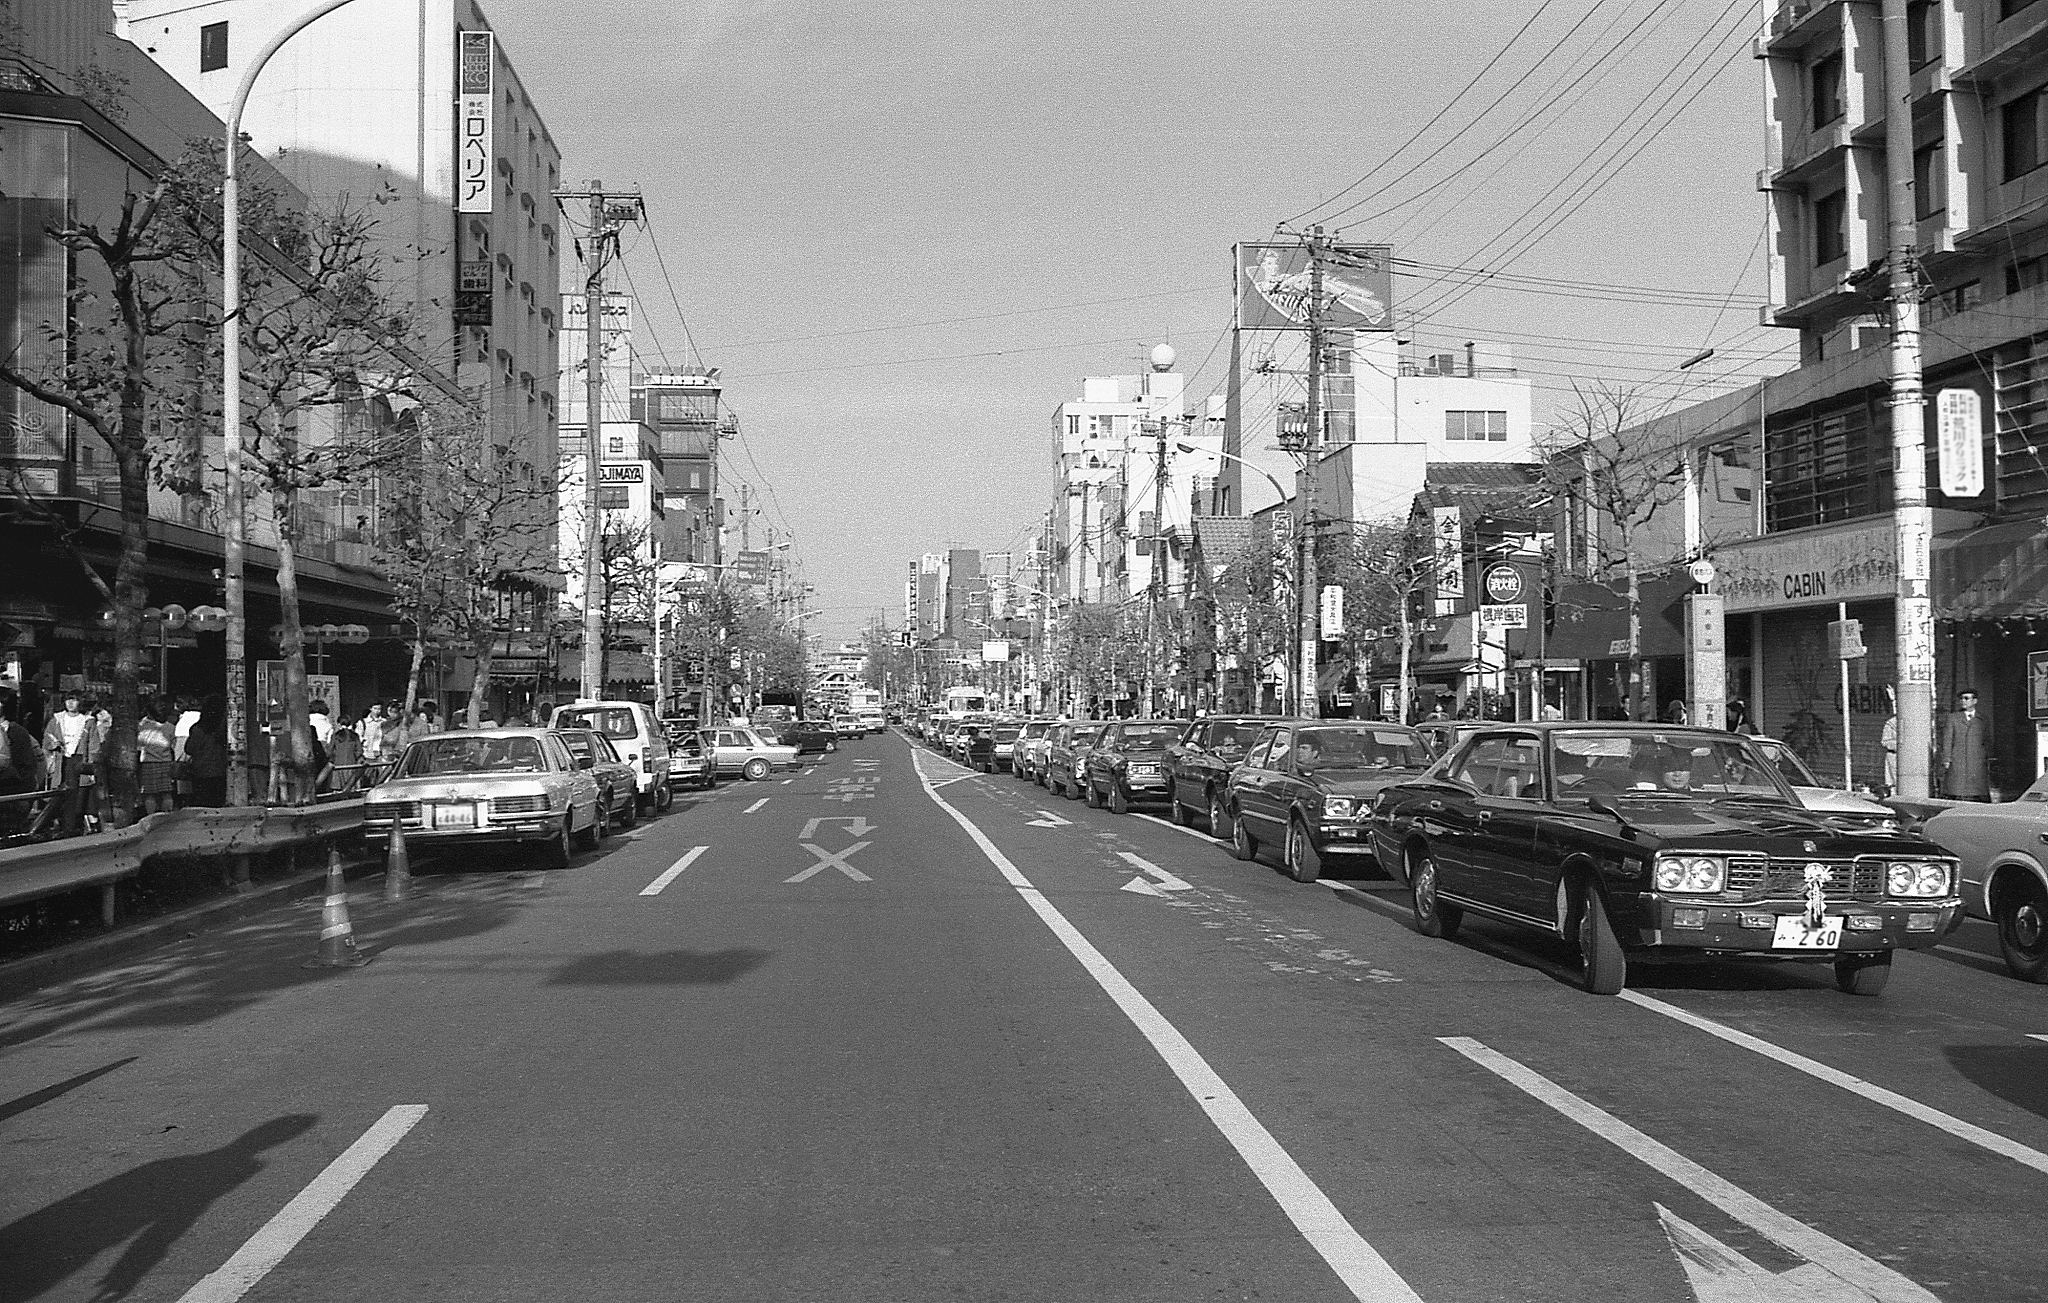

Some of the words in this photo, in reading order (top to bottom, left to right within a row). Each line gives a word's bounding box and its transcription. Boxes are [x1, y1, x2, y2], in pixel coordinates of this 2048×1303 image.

[466, 118, 486, 201] ロベリア
[1490, 577, 1518, 591] 消火栓
[1783, 571, 1826, 598] CABIN
